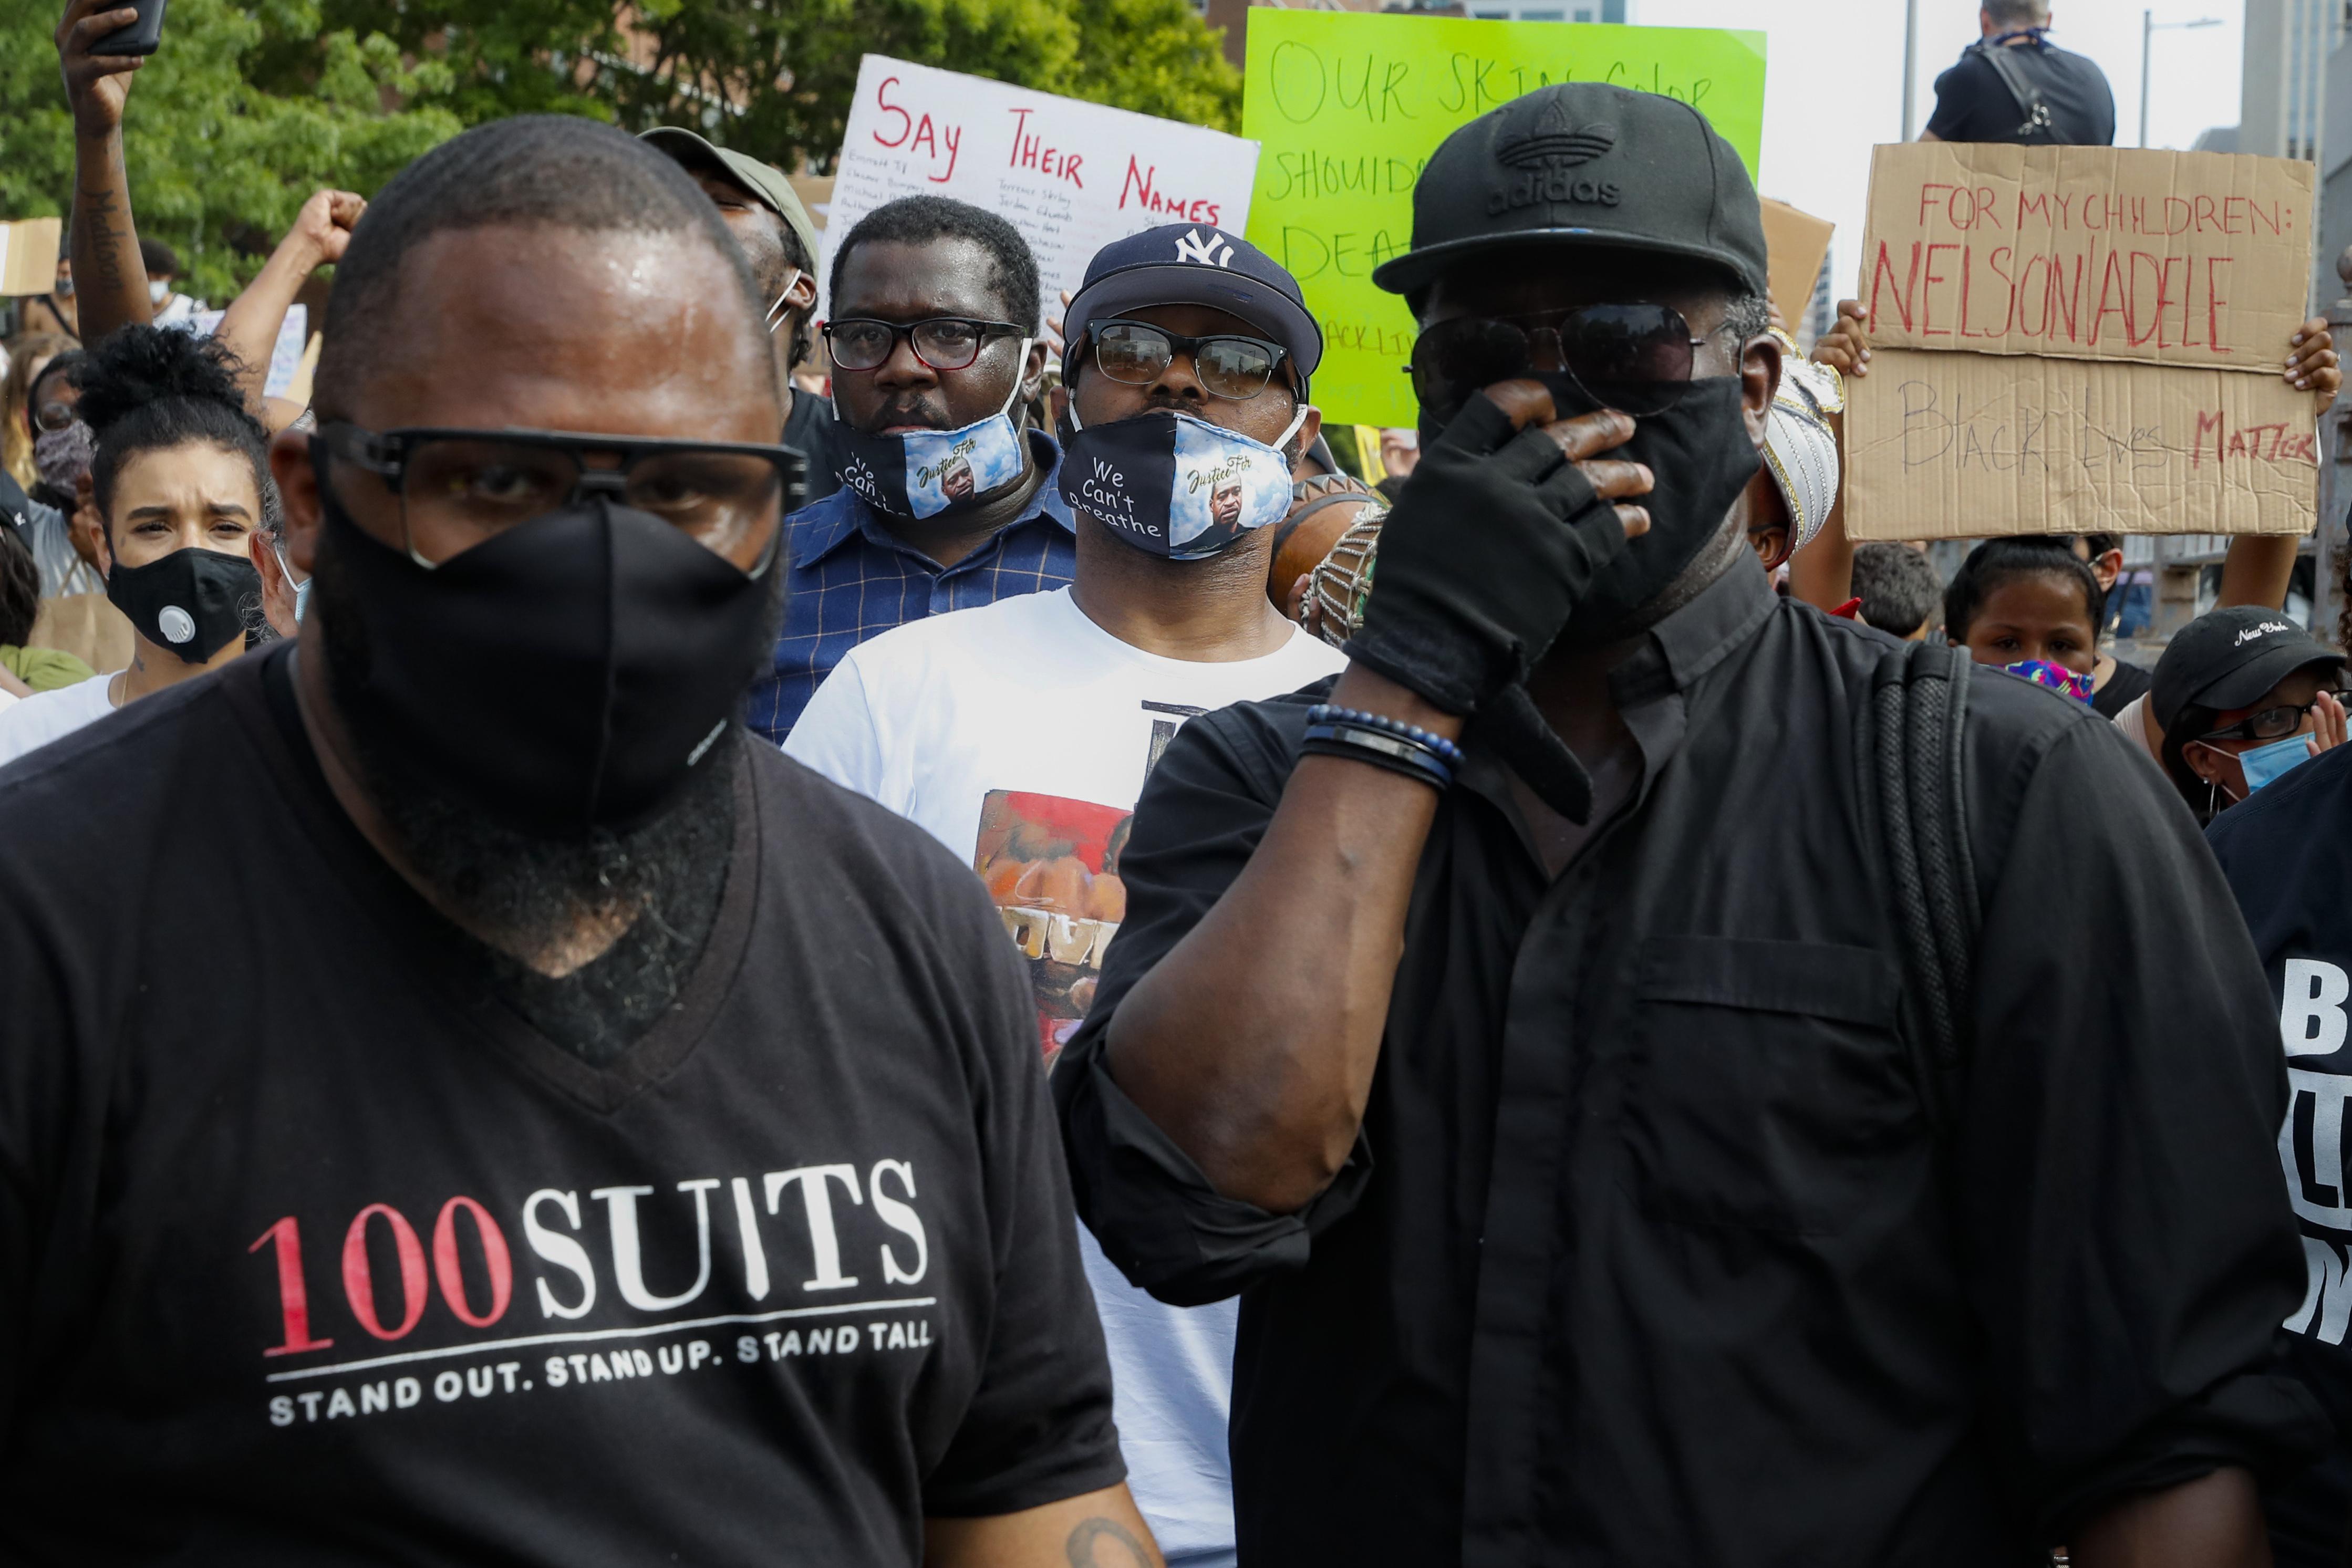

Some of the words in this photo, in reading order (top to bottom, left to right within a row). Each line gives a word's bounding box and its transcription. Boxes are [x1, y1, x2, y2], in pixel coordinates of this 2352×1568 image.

[1271, 40, 1418, 124] OUR
[1008, 108, 1084, 189] THEIR
[1118, 154, 1220, 227] NAMES
[1487, 167, 1621, 217] adidas
[1920, 184, 2001, 230] FOR
[2018, 191, 2071, 231] MY
[1175, 227, 1235, 268] NY
[1283, 226, 1411, 281] DEA
[1323, 319, 1378, 352] ACK
[1093, 456, 1124, 488] We
[1082, 478, 1136, 514] Can't
[2234, 628, 2263, 647] New
[269, 1375, 421, 1427] STAND
[434, 1362, 533, 1403] OUT.
[546, 1347, 653, 1386] STAND
[737, 1325, 859, 1364] STAND
